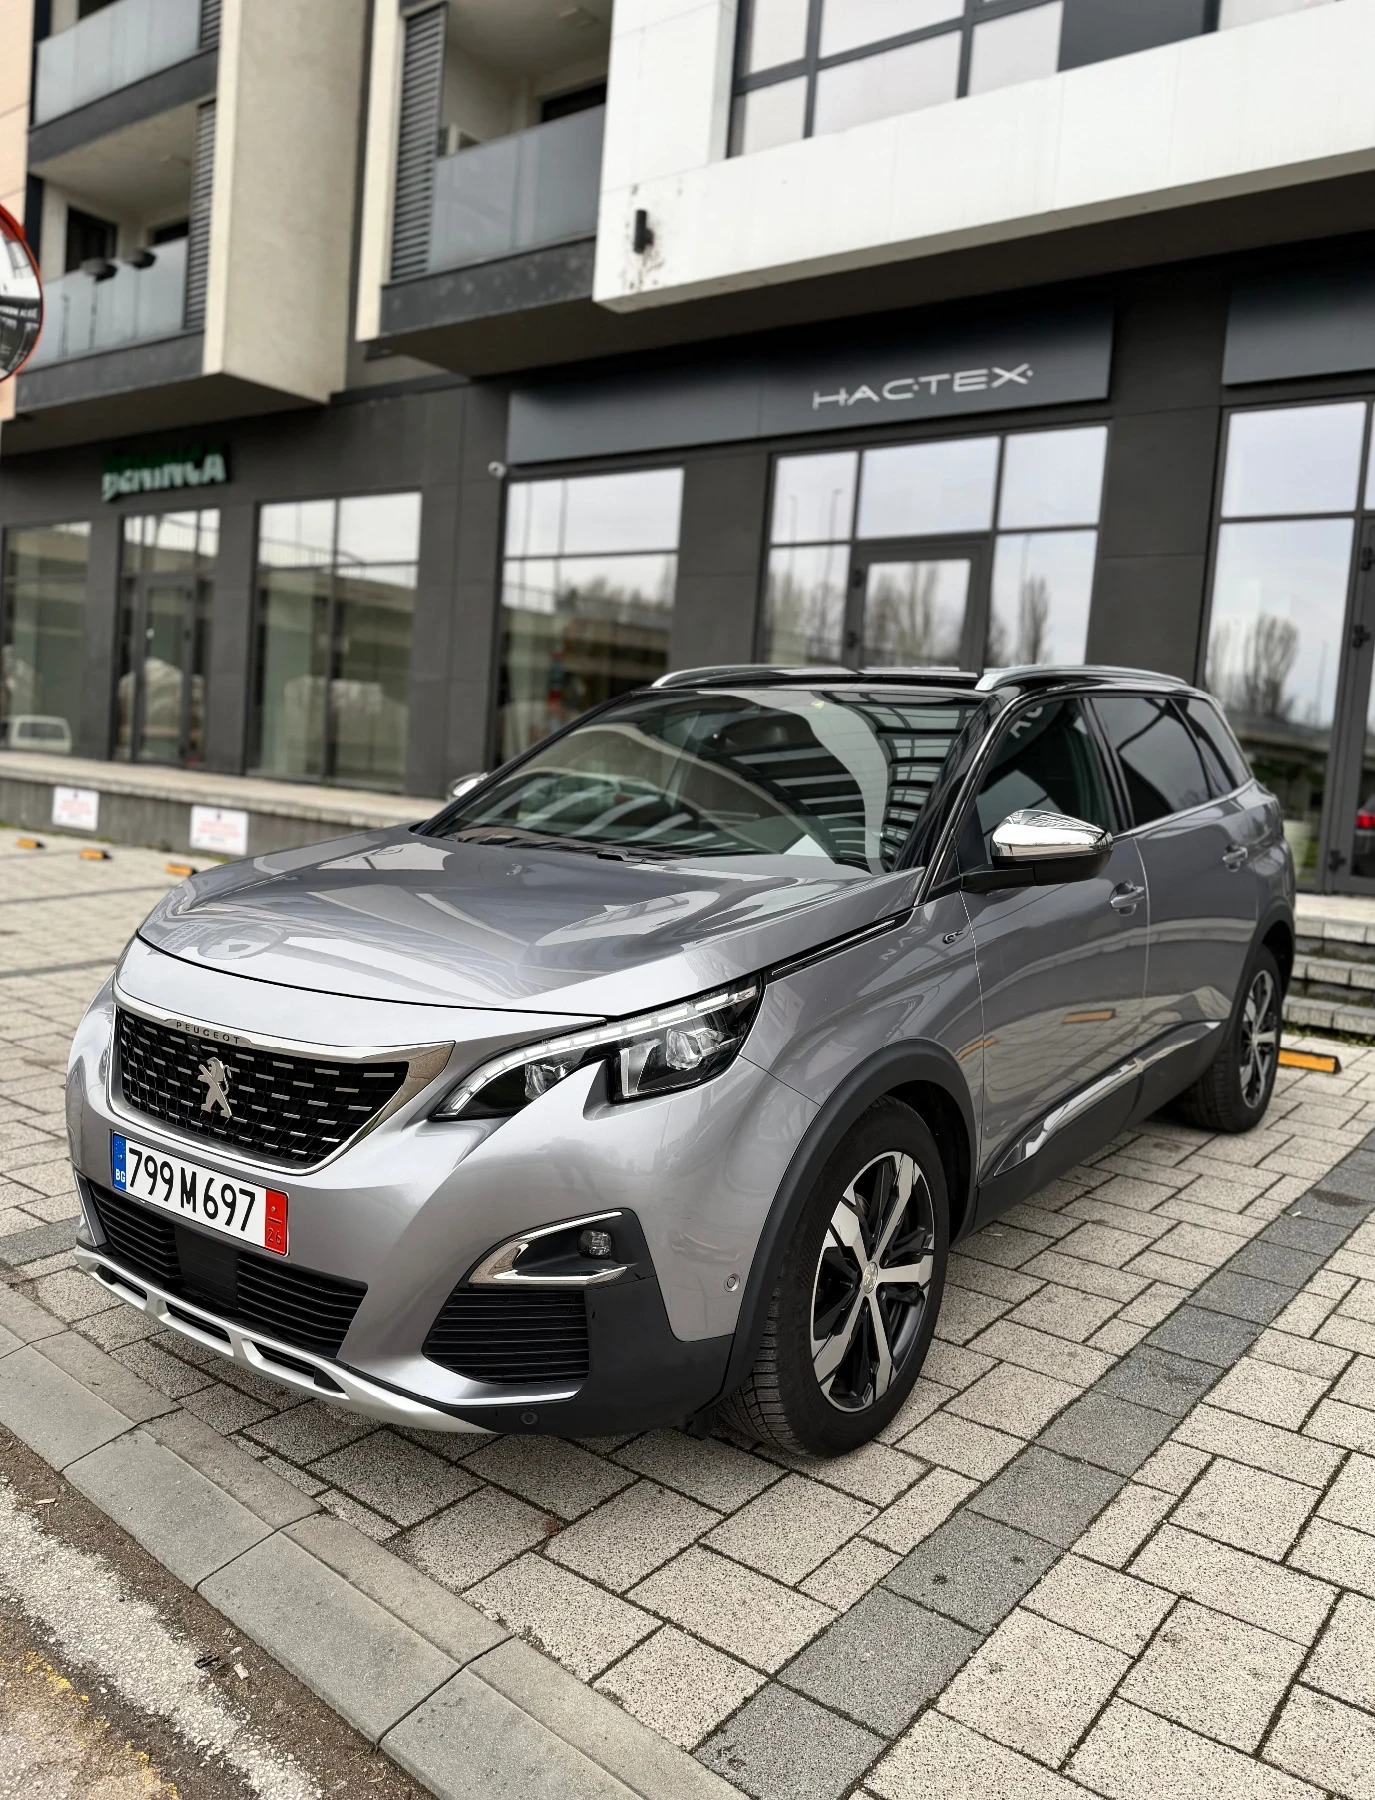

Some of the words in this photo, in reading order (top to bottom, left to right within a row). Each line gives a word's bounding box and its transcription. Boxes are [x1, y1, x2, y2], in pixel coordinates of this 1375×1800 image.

[176, 1021, 240, 1044] PEUGEOT
[115, 1168, 126, 1183] BG
[267, 1228, 282, 1245] 26
